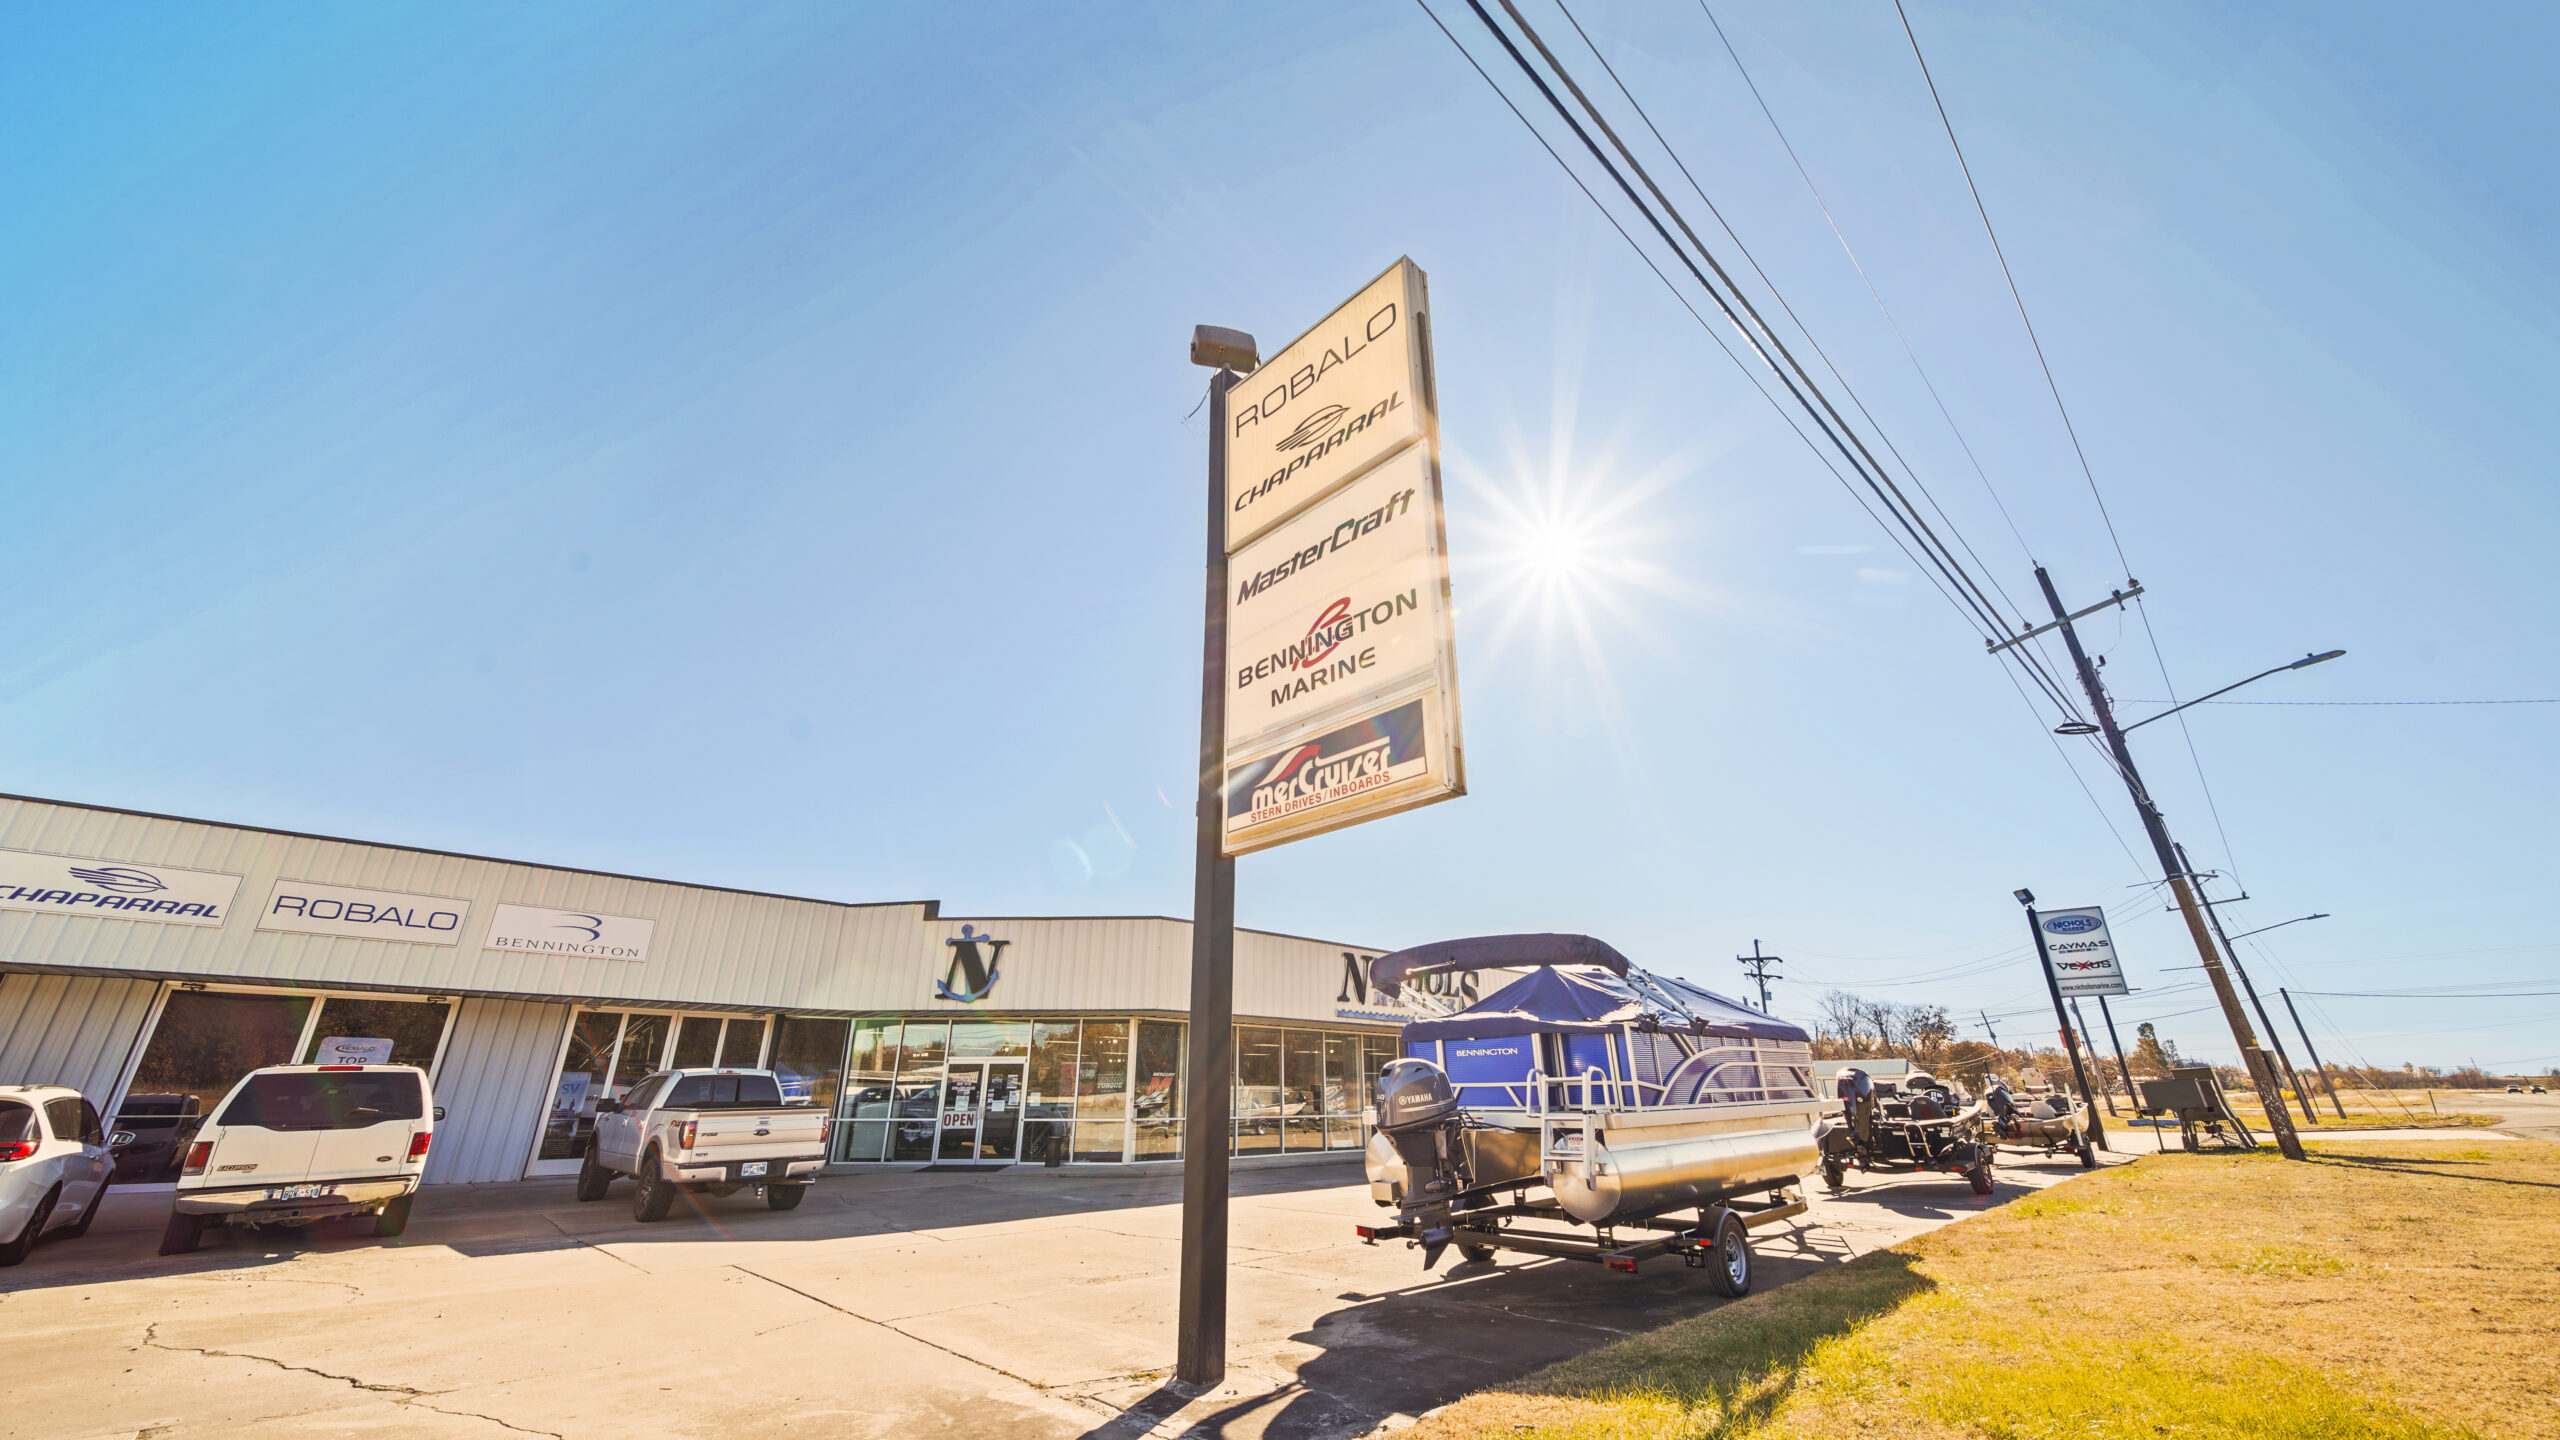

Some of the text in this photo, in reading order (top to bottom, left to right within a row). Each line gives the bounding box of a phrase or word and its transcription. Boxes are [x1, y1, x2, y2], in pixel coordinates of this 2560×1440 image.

[1236, 303, 1396, 437] ROBALO
[1235, 391, 1404, 511] CHAPARRAL
[1237, 488, 1415, 605] MasterCraft
[1238, 589, 1417, 689] BENNINGTON
[1271, 646, 1375, 707] MARINE
[1251, 806, 1281, 822] STERN
[272, 895, 459, 931] ROBALO
[2053, 919, 2092, 929] NICHOLS
[496, 937, 640, 958] BENNINGTON
[2049, 940, 2108, 950] CAYMAS
[1337, 952, 1478, 1004] NOLS
[2061, 983, 2123, 991] www.nicholsmarine.com
[1456, 1048, 1518, 1057] BENNINGTON
[1407, 1093, 1432, 1104] YAMAHA
[944, 1114, 974, 1126] OPEN
